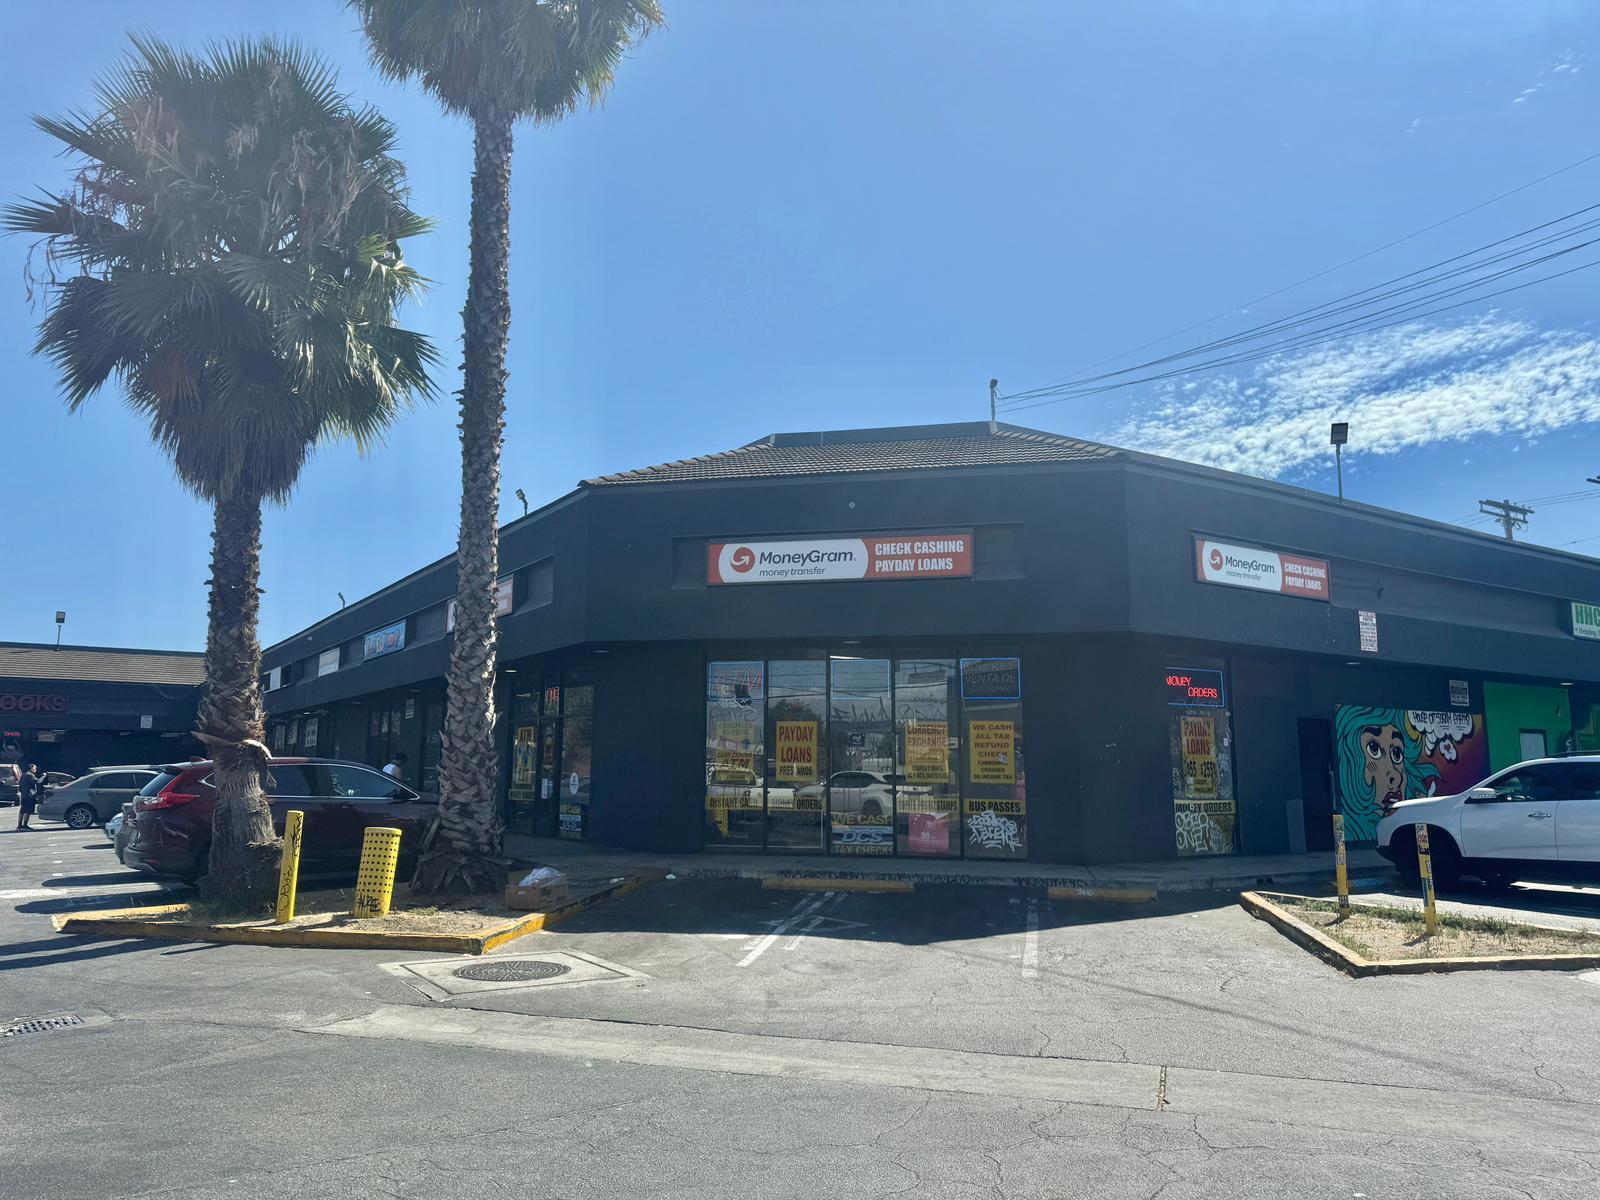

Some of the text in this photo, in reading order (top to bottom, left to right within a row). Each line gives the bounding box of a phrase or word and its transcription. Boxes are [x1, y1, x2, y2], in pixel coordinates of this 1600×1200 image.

[874, 540, 964, 556] CHECK CASHING
[759, 550, 853, 567] MoneyGram
[875, 557, 953, 573] PAYDAY LOANS
[1225, 556, 1275, 574] MoneyGram
[759, 567, 826, 577] money transfer
[1284, 562, 1326, 578] CHECK CASHING
[1285, 576, 1322, 591] PAYDAY LOANS
[1187, 687, 1218, 698] ORDERS
[779, 726, 814, 742] PAYDAY
[1186, 739, 1210, 755] LOANS
[781, 747, 812, 763] LOANS
[779, 766, 813, 776] PRESAMOS
[710, 797, 738, 808] INSTANT
[797, 799, 823, 810] ORDERS
[969, 801, 1021, 813] BUS PASSES
[1204, 802, 1232, 813] ORDERS
[832, 814, 855, 825] WE
